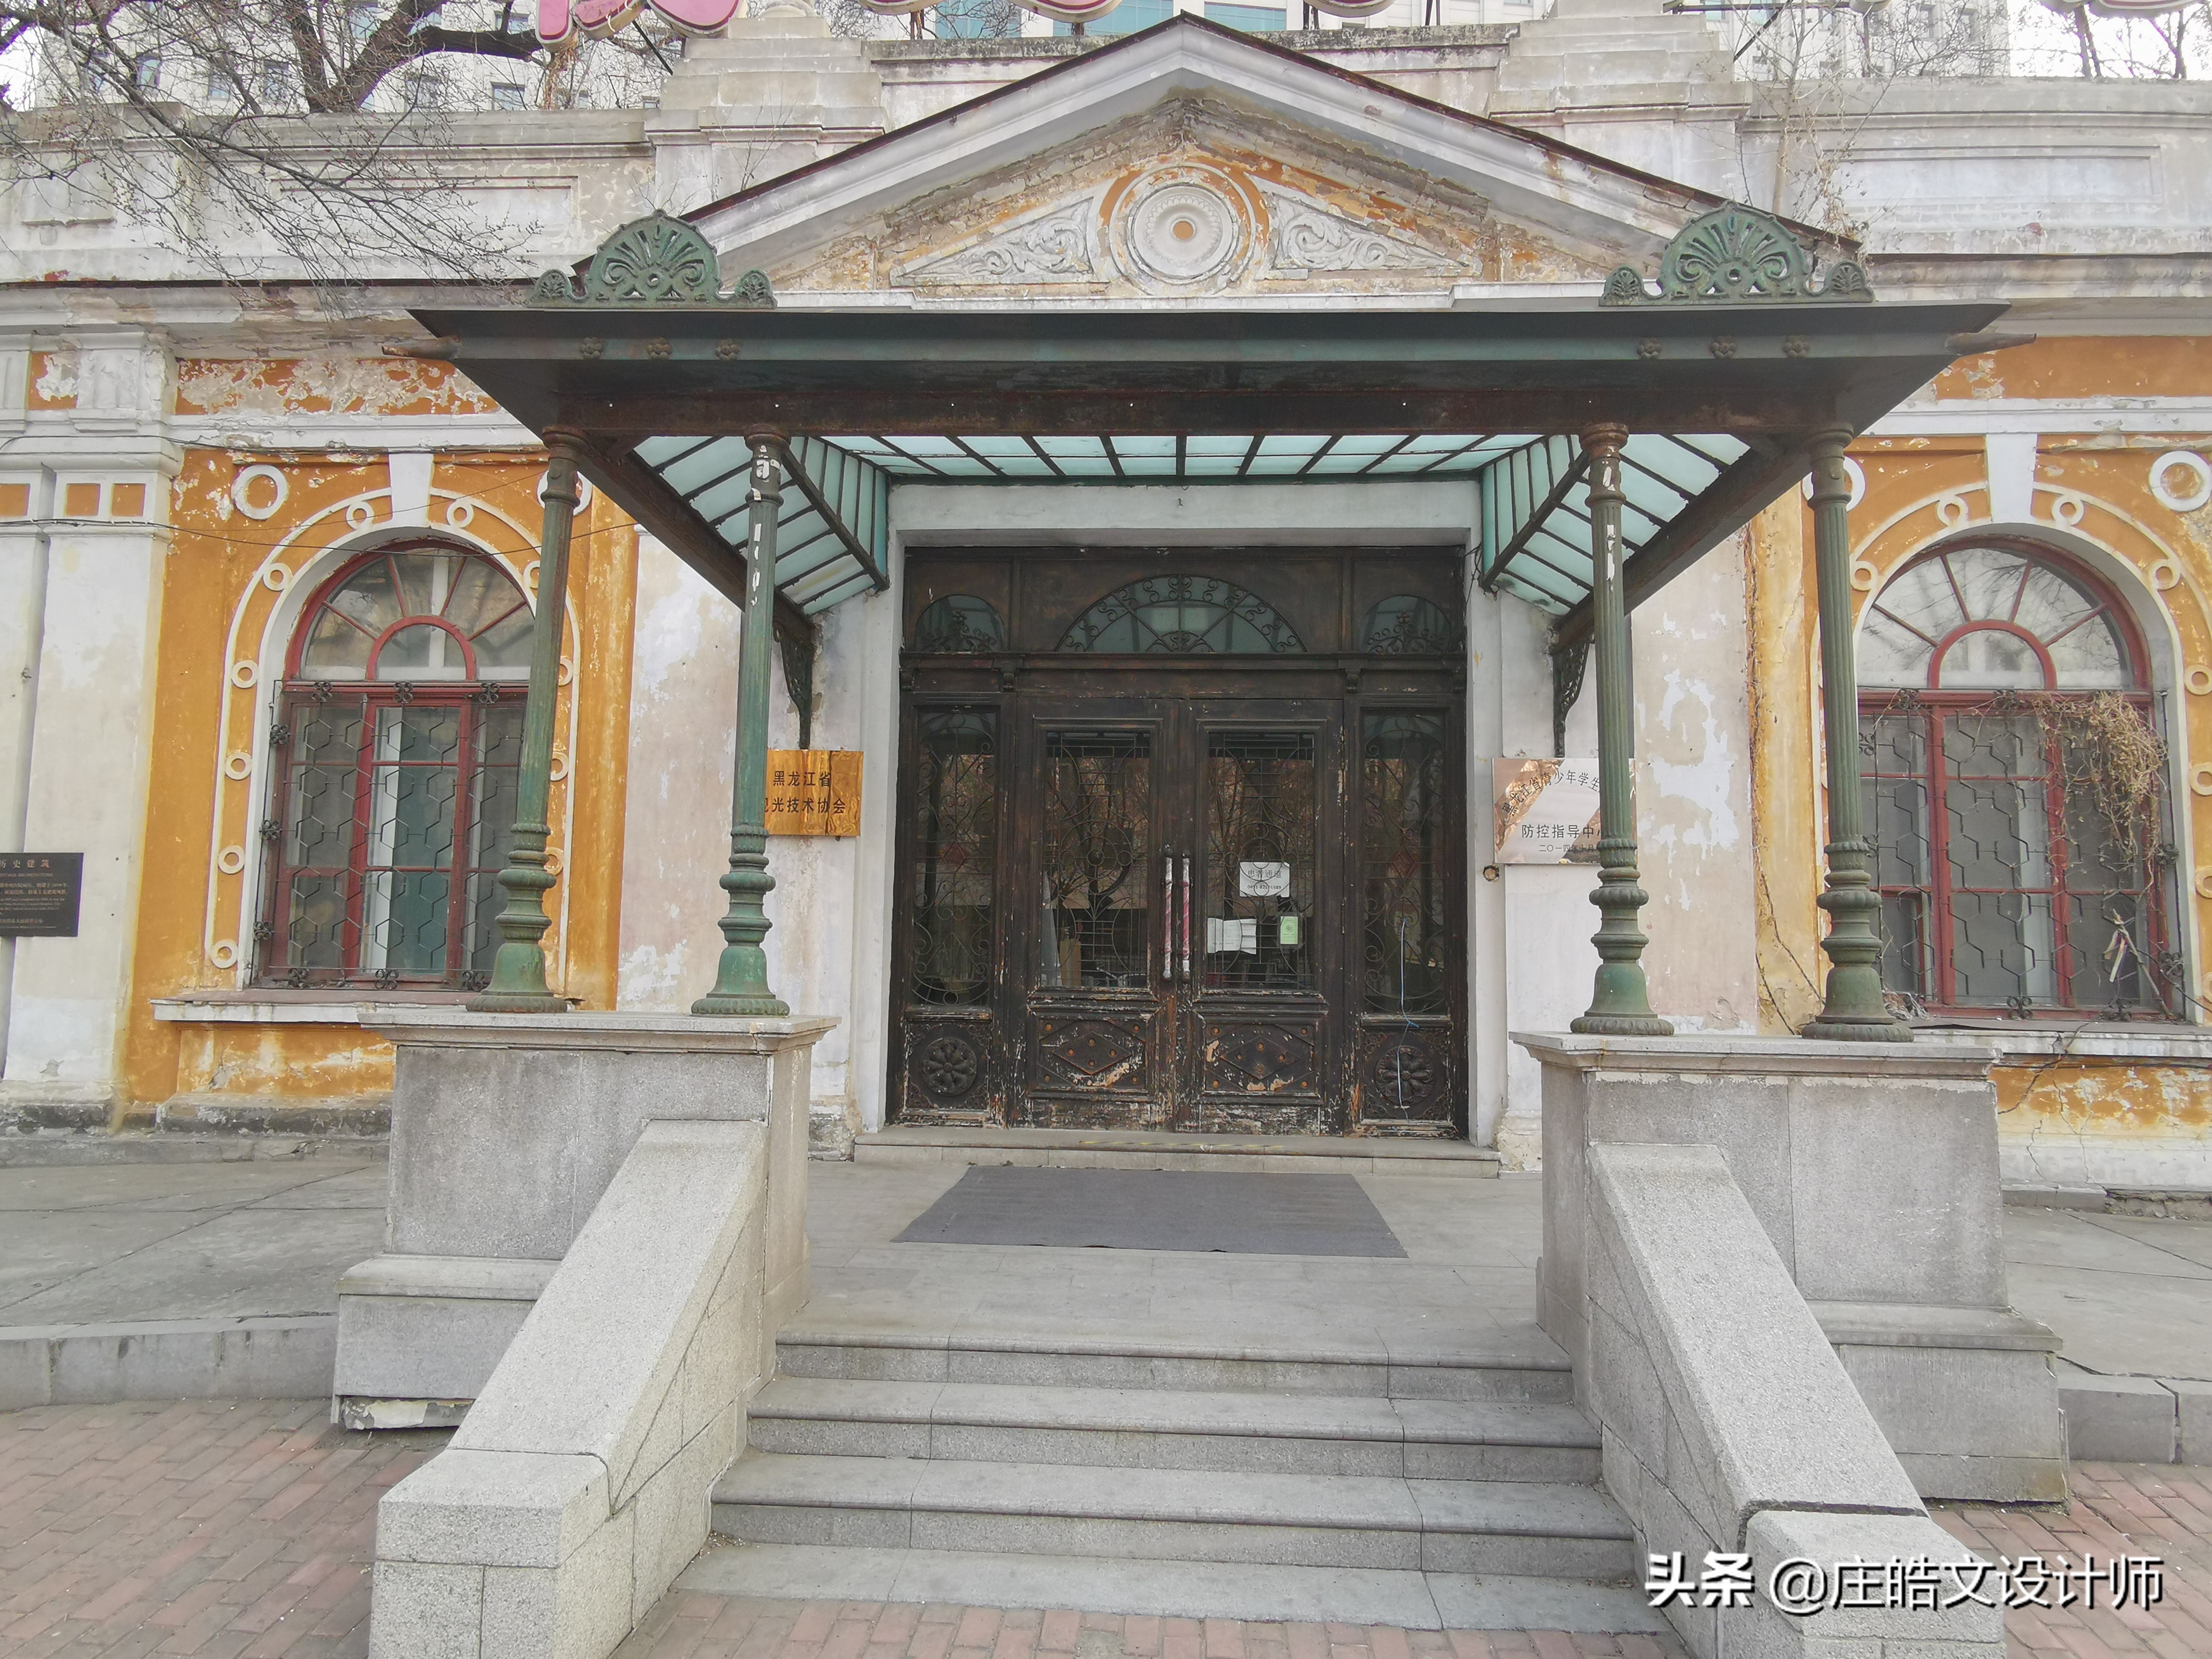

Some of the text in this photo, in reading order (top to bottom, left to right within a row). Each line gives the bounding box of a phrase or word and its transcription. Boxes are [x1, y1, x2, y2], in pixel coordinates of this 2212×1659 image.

[773, 771, 831, 787] 黑龙江省
[1502, 769, 1600, 816] 黑龙江省青少年学生
[1522, 824, 1601, 839] 防控指导中
